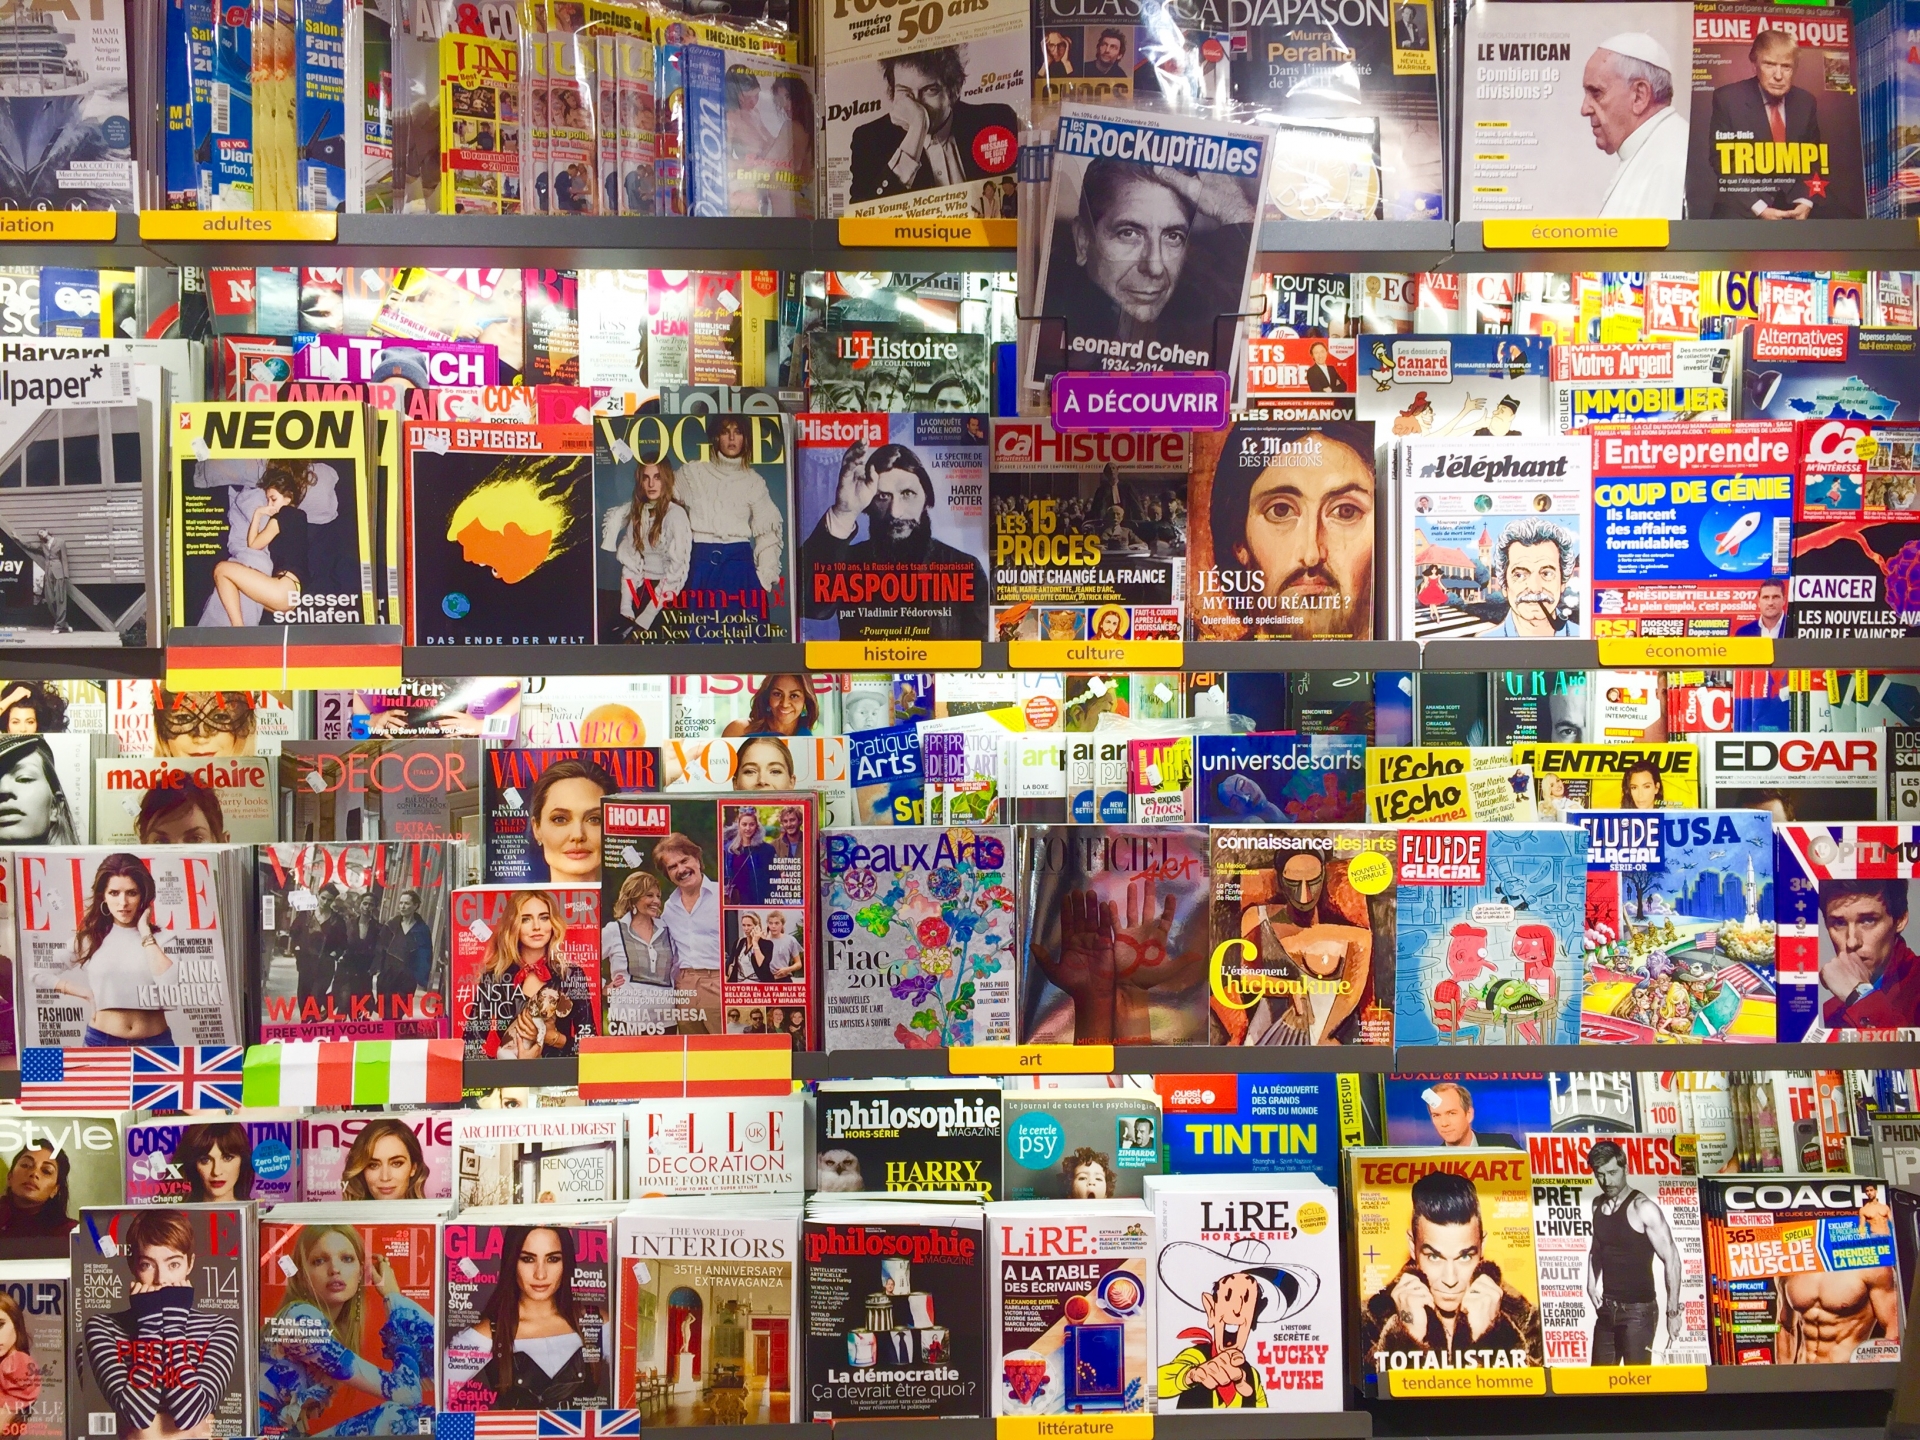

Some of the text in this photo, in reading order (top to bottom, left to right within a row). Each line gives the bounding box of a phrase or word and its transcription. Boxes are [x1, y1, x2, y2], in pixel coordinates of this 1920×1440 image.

[898, 4, 943, 44] 50
[852, 25, 891, 40] spécial
[1477, 43, 1570, 61] LE VATICAN
[981, 70, 1023, 87] 50 de
[1477, 66, 1560, 83] Combien de
[964, 87, 983, 97] rock
[996, 83, 1006, 91] de
[1477, 82, 1539, 99] divisions
[828, 99, 881, 122] Dylan
[1070, 119, 1084, 131] les
[1716, 129, 1754, 140] États-Unis
[1716, 142, 1829, 174] TRUMP!
[854, 206, 876, 218] Neil
[202, 216, 272, 232] adultes
[894, 222, 972, 240] musique
[1531, 224, 1618, 239] économie
[1274, 275, 1345, 297] TOUT SUR
[1758, 329, 1843, 346] Alternatives
[842, 337, 958, 360] L'Histoire
[1147, 342, 1209, 367] Cohen
[1397, 356, 1448, 370] Canard
[1572, 355, 1672, 376] Votre Argent
[1064, 390, 1218, 413] À DÉCOUVRIR
[1575, 389, 1726, 413] IMMOBILIER
[928, 418, 961, 426] CONQUÊTE
[1275, 409, 1353, 421] ROMANOV
[205, 410, 355, 450] NEON
[799, 420, 881, 441] Historia
[928, 426, 942, 434] PÔLE
[457, 428, 542, 450] SPIEGEL
[1239, 455, 1323, 468] DES RELIGIONS
[1606, 438, 1789, 469] Entreprendre
[951, 485, 982, 496] HARRY
[1595, 472, 1791, 507] COUP DE GÉNIE
[948, 495, 982, 506] POTTER
[998, 500, 1056, 535] LES 15
[1625, 508, 1676, 522] lancent
[1632, 522, 1687, 536] affaires
[998, 534, 1101, 566] PROCÈS
[1606, 536, 1689, 551] formidables
[998, 567, 1165, 584] QUI ONT CHANGÉ LA FRANCE
[1197, 565, 1265, 595] JÉSUS
[814, 573, 974, 603] RASPOUTINE
[1627, 589, 1757, 600] PRÉSIDENTIELLES 2017
[1798, 578, 1873, 599] CANCER
[288, 591, 358, 607] Besser
[1202, 592, 1341, 610] MYTHE OU RÉALITÉ
[1643, 600, 1757, 612] plein possible
[273, 608, 359, 624] schlafen
[662, 611, 758, 625] Winter-Looks
[858, 606, 952, 618] Vladimir Fédorovski
[1202, 615, 1304, 626] Querelles spécialistes
[633, 624, 788, 639] von New Cocktail Chic
[427, 636, 585, 645] DAS ENDE DER WELT
[864, 647, 927, 662] histoire
[1066, 647, 1124, 660] culture
[1645, 644, 1727, 657] économie
[1715, 741, 1877, 771] EDGAR
[858, 752, 917, 781] Arts
[107, 760, 266, 790] marie claire
[492, 809, 529, 818] PANTOJA
[1665, 815, 1741, 848] USA
[826, 940, 889, 972] Fiac
[848, 965, 901, 990] 2016
[457, 984, 525, 1005] #INSTA
[38, 1007, 84, 1023] FASHION!
[463, 1003, 513, 1020] CHIC
[608, 1006, 707, 1022] MARÍA TERESA
[828, 1006, 859, 1014] TENDANCES
[608, 1022, 665, 1036] CAMPOS
[840, 1018, 891, 1028] ARTISTES SUIVRE
[1020, 1053, 1042, 1067] art
[1261, 1084, 1319, 1095] LA DÉCOUVERTE
[1268, 1096, 1300, 1105] GRANDS
[832, 1098, 1000, 1138] philosophie
[1252, 1106, 1318, 1116] PORTS DU MONDE
[459, 1121, 616, 1140] ARCHITECTURAL DIGEST
[845, 1128, 900, 1138] HORS-SÉRIE
[1186, 1123, 1317, 1154] TINTIN
[1019, 1132, 1058, 1158] psy
[542, 1157, 604, 1170] RENOVATE
[648, 1154, 784, 1174] DECORATION
[558, 1179, 604, 1192] WORLD
[710, 1174, 792, 1185] CHRISTMAS
[1725, 1183, 1886, 1211] COACH
[631, 1237, 785, 1259] INTERIORS
[1728, 1238, 1814, 1261] PRISE DE
[1730, 1254, 1816, 1278] MUSCLE
[84, 1273, 123, 1286] EMMA
[571, 1277, 606, 1290] Lovato
[695, 1276, 784, 1287] EXTRAVAGANZA
[84, 1285, 122, 1298] STONE
[265, 1317, 322, 1327] FEARLESS
[271, 1327, 334, 1337] FEMININITY
[116, 1340, 209, 1363] PRETTY
[853, 1368, 959, 1384] démocratie
[1402, 1375, 1533, 1389] tendance homme
[1608, 1372, 1652, 1389] poker
[840, 1382, 965, 1400] devrait être quoi
[1038, 1421, 1114, 1436] littérature
